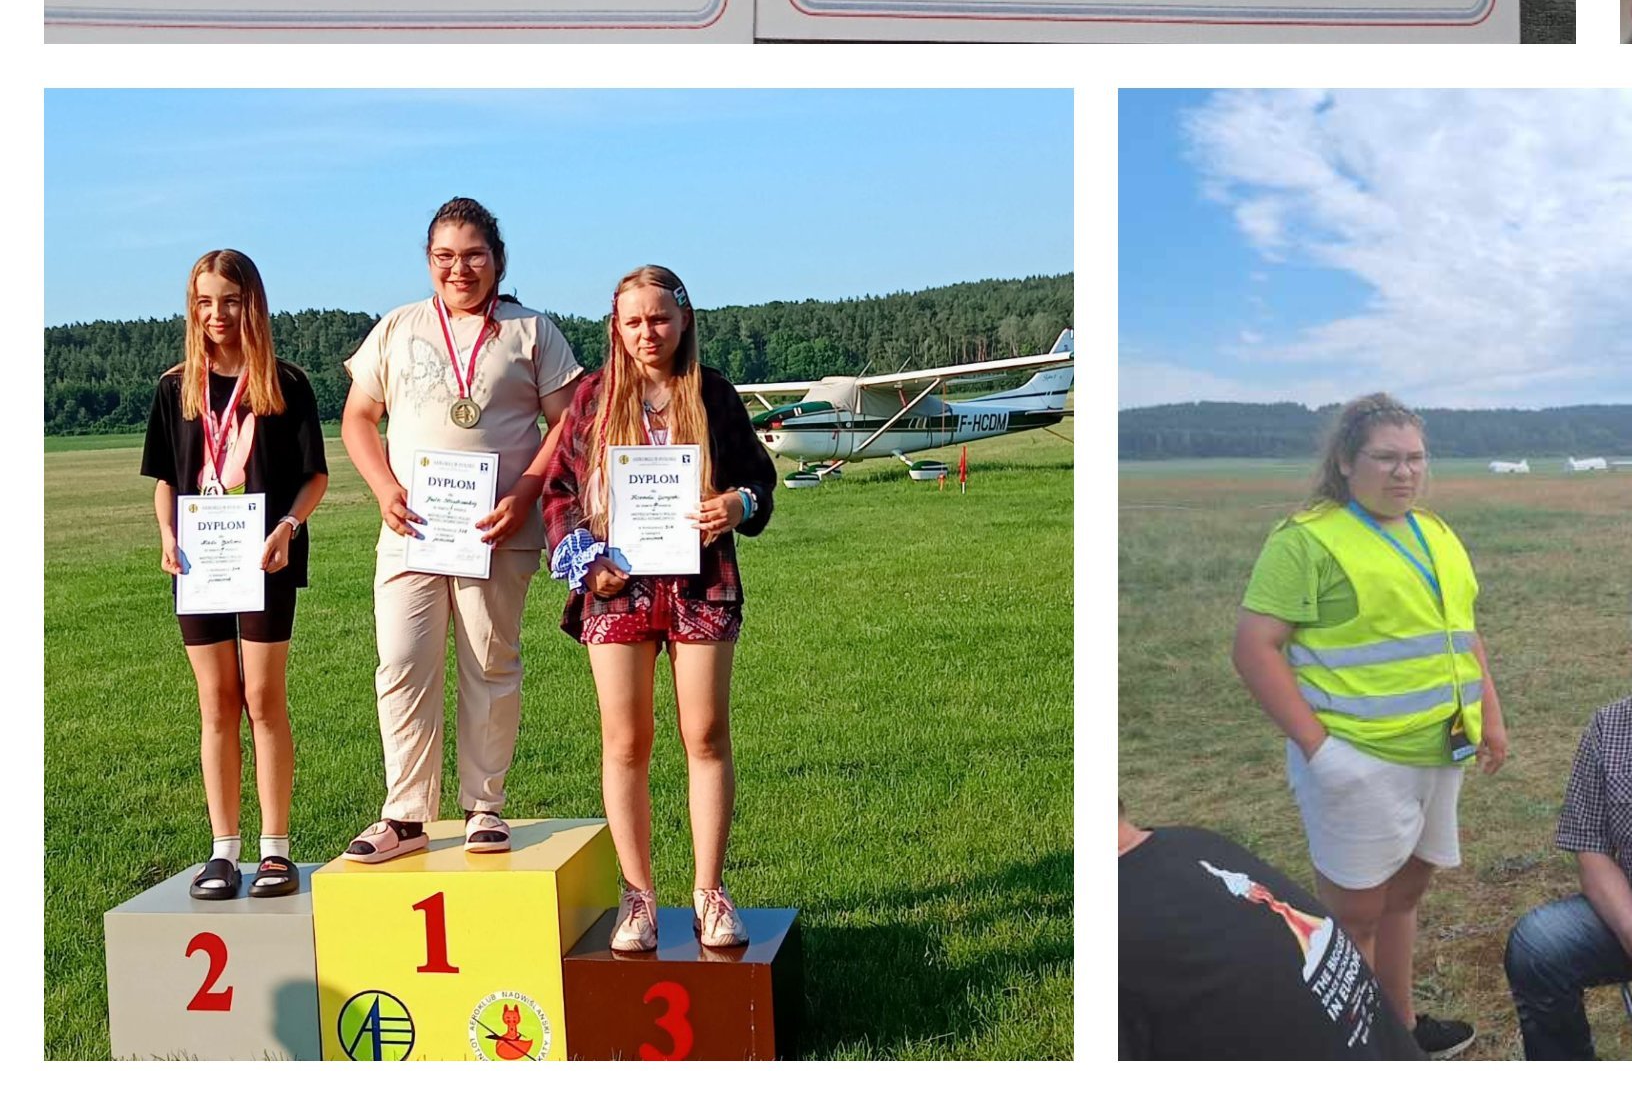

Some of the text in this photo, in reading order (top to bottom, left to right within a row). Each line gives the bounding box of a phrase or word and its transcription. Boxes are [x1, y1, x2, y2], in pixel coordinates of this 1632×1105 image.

[959, 413, 1007, 432] F-HCDM
[428, 477, 476, 491] DYPLOM
[629, 474, 679, 484] DYPLOM
[198, 521, 246, 531] DYPLOM
[412, 892, 460, 973] 1
[185, 931, 233, 1011] 2
[1312, 968, 1332, 996] THE
[639, 981, 694, 1061] 3
[1327, 998, 1343, 1021] IN
